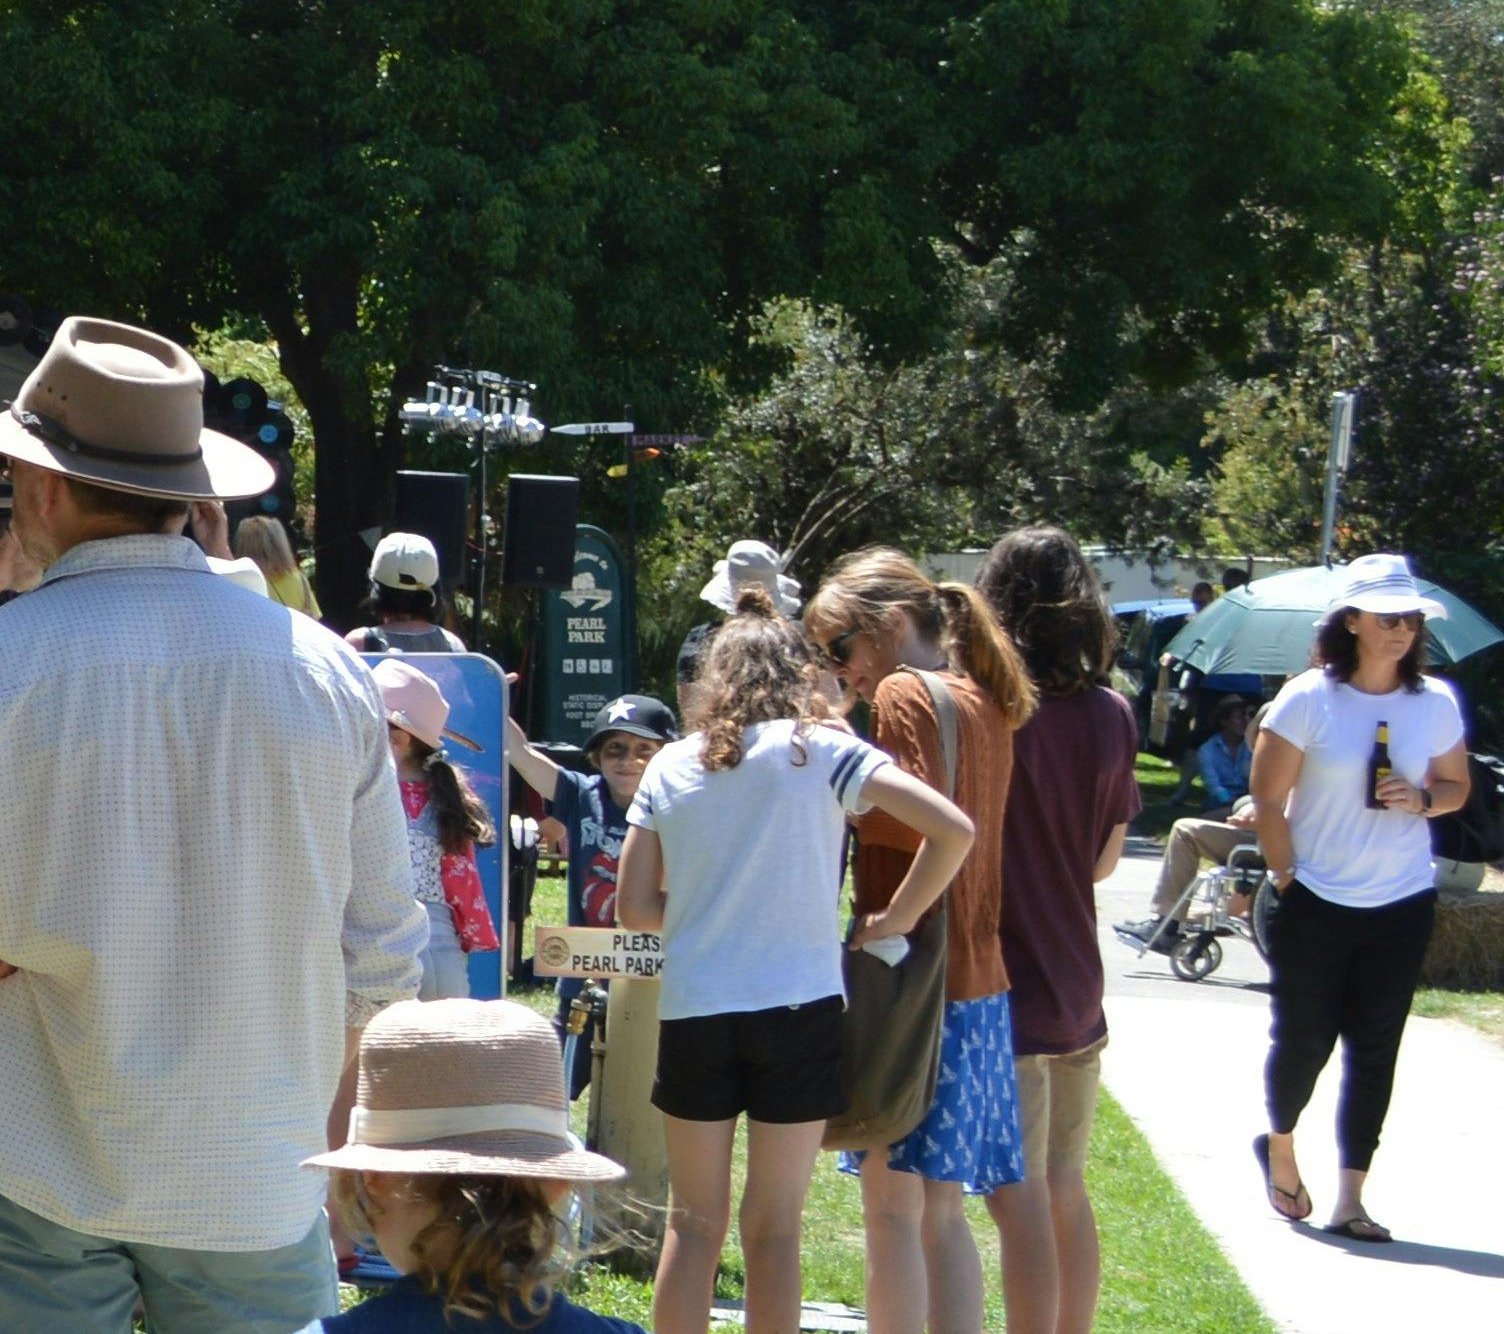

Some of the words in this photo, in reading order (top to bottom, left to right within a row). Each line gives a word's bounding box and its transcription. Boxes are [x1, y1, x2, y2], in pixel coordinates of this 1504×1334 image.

[566, 617, 608, 630] PEARL
[567, 631, 606, 644] PARK
[613, 933, 661, 953] PLEAS
[571, 955, 620, 972] PEARL
